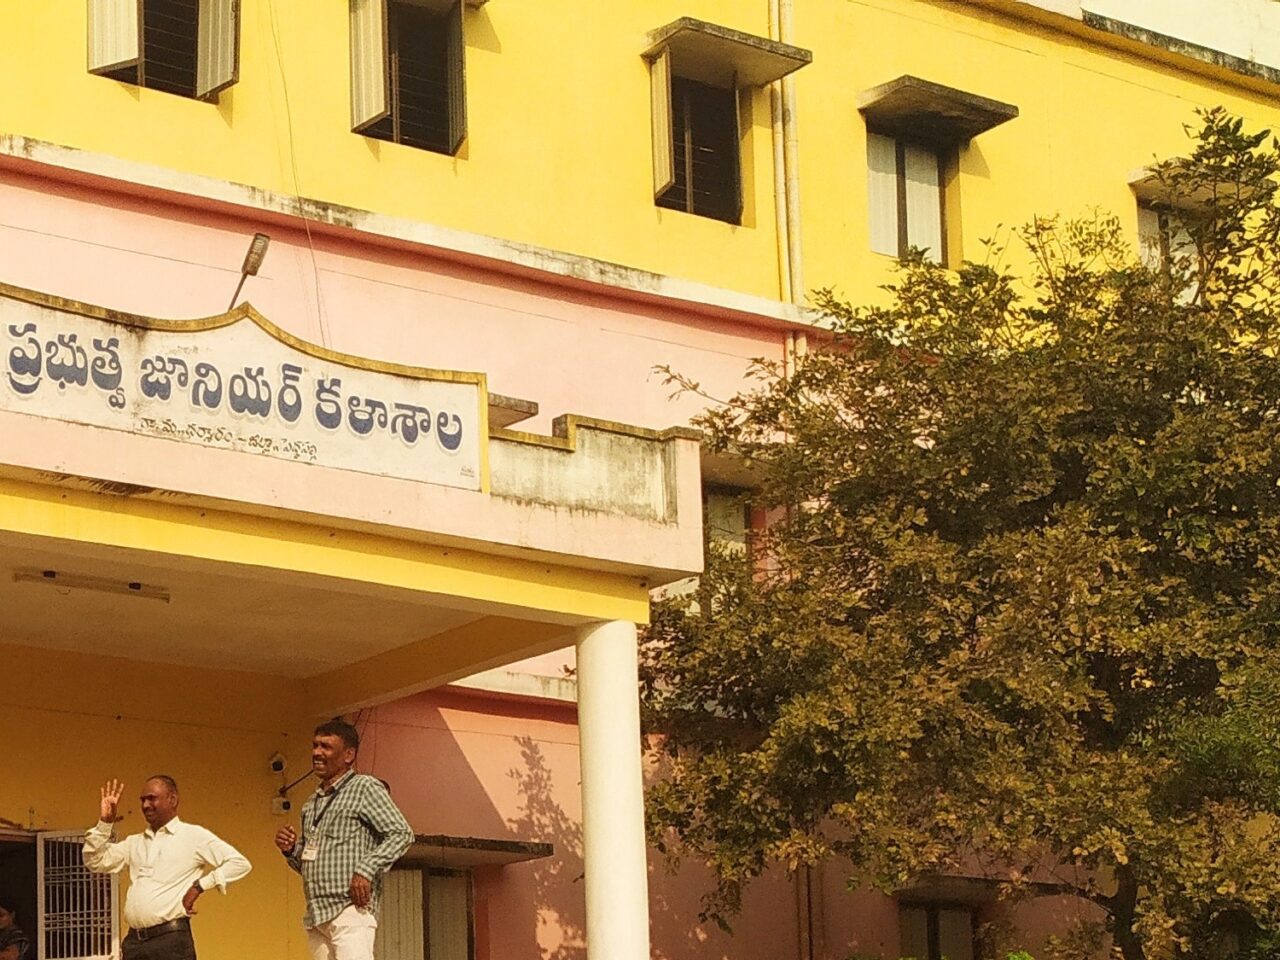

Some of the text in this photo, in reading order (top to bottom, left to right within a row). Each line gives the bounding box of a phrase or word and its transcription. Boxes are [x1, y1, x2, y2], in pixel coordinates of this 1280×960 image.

[6, 323, 463, 450] ప్రభుత్వ జూనియర్ కళాశాల
